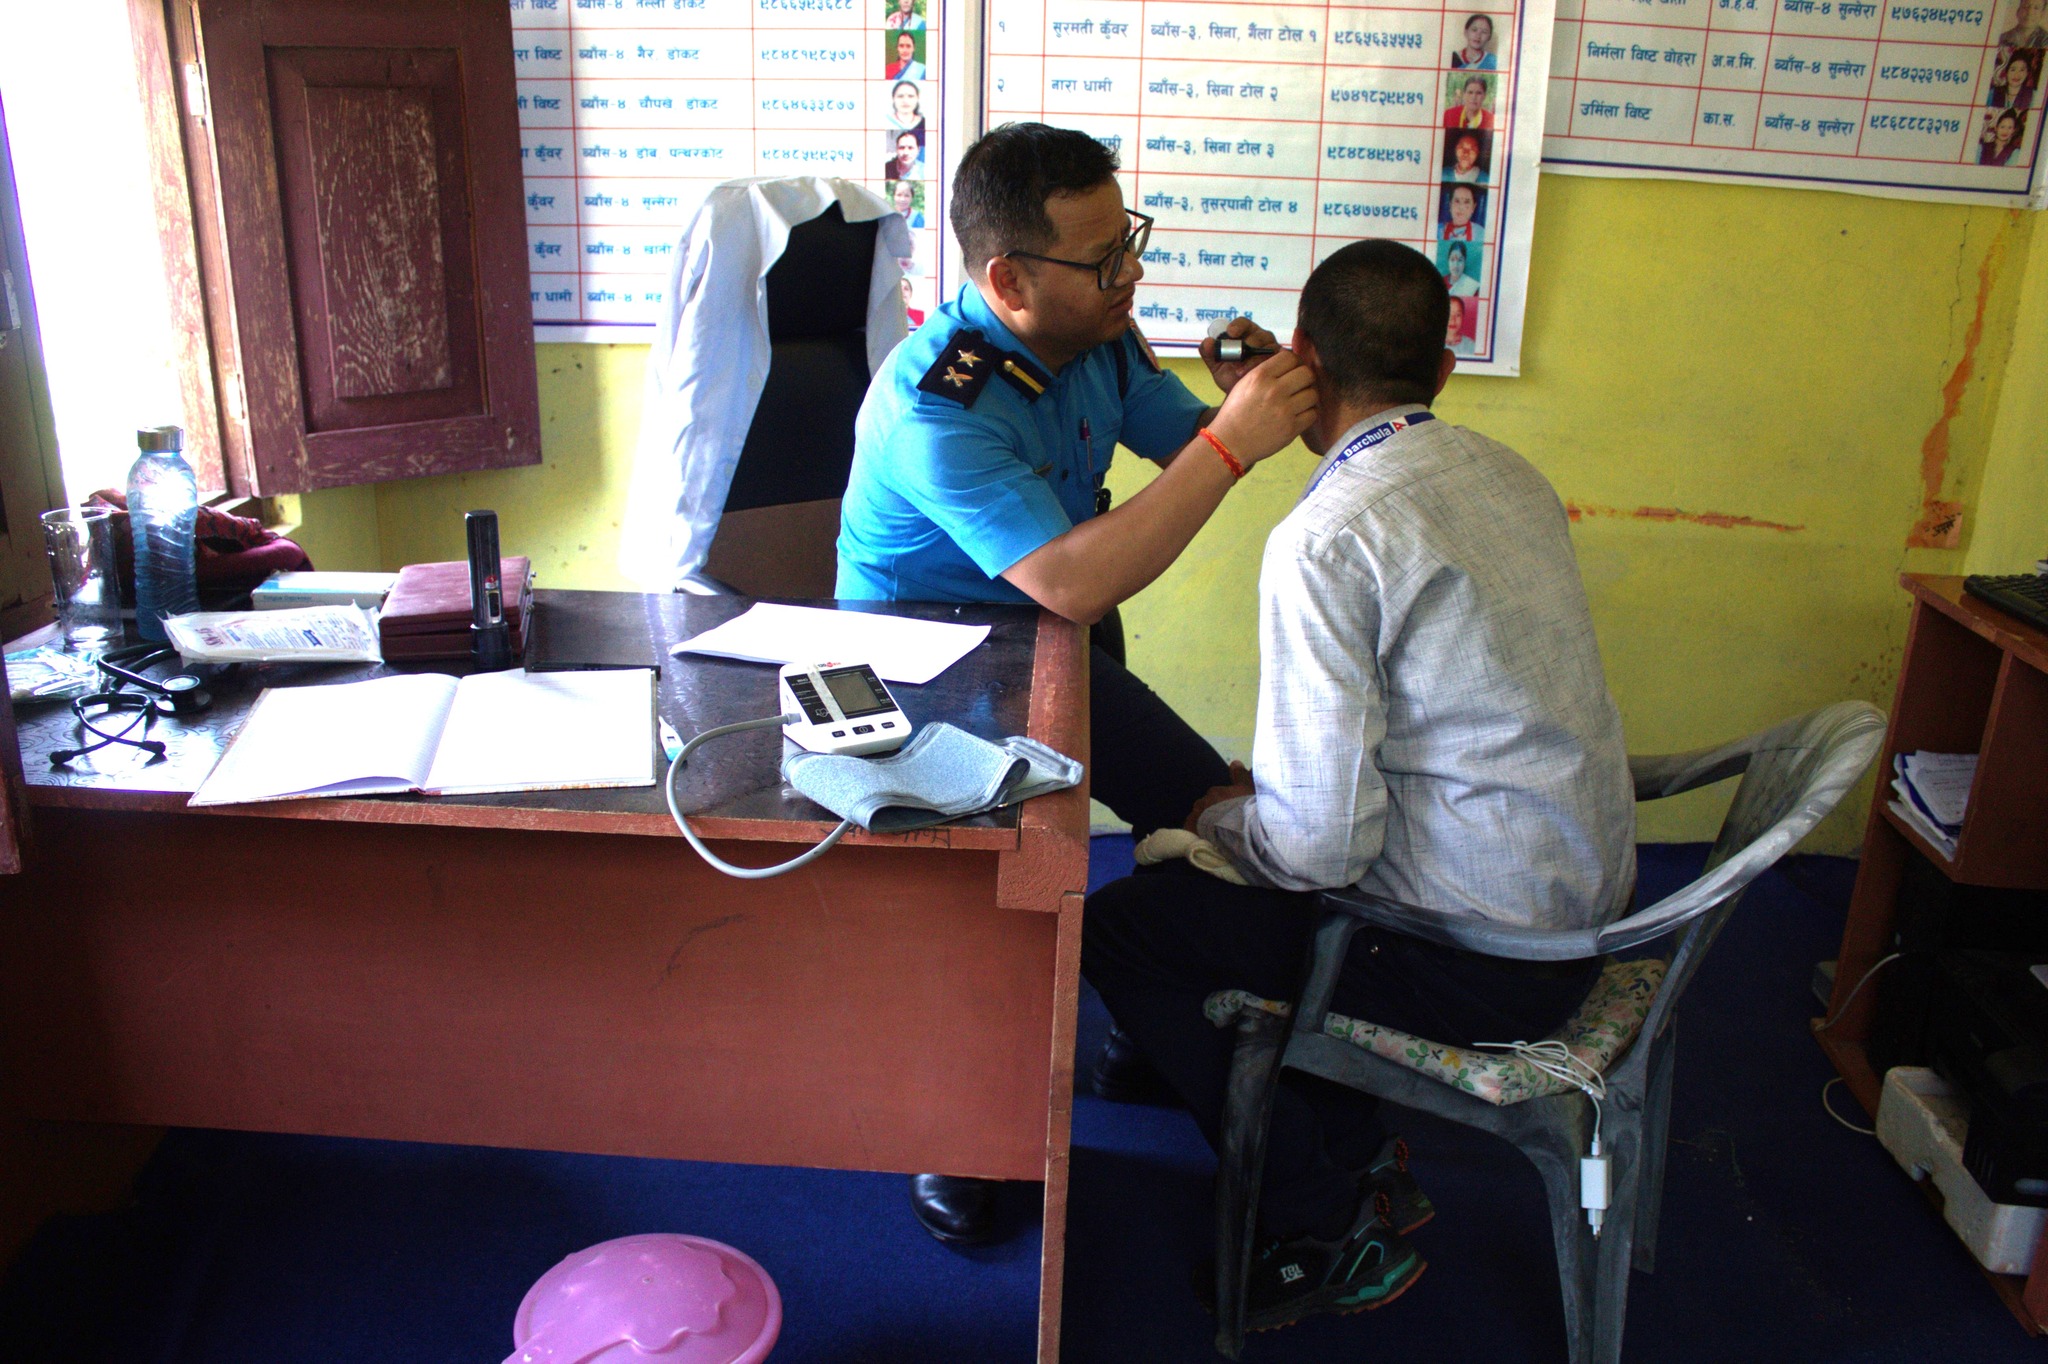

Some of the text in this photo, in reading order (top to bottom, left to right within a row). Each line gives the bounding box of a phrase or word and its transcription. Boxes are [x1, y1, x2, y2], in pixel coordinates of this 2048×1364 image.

[1278, 25, 1304, 42] टोल
[1240, 83, 1264, 98] टोल
[1237, 140, 1262, 156] टोल
[1258, 197, 1283, 213] टोल
[1231, 252, 1256, 268] टोल
[1343, 427, 1392, 458] Darchula
